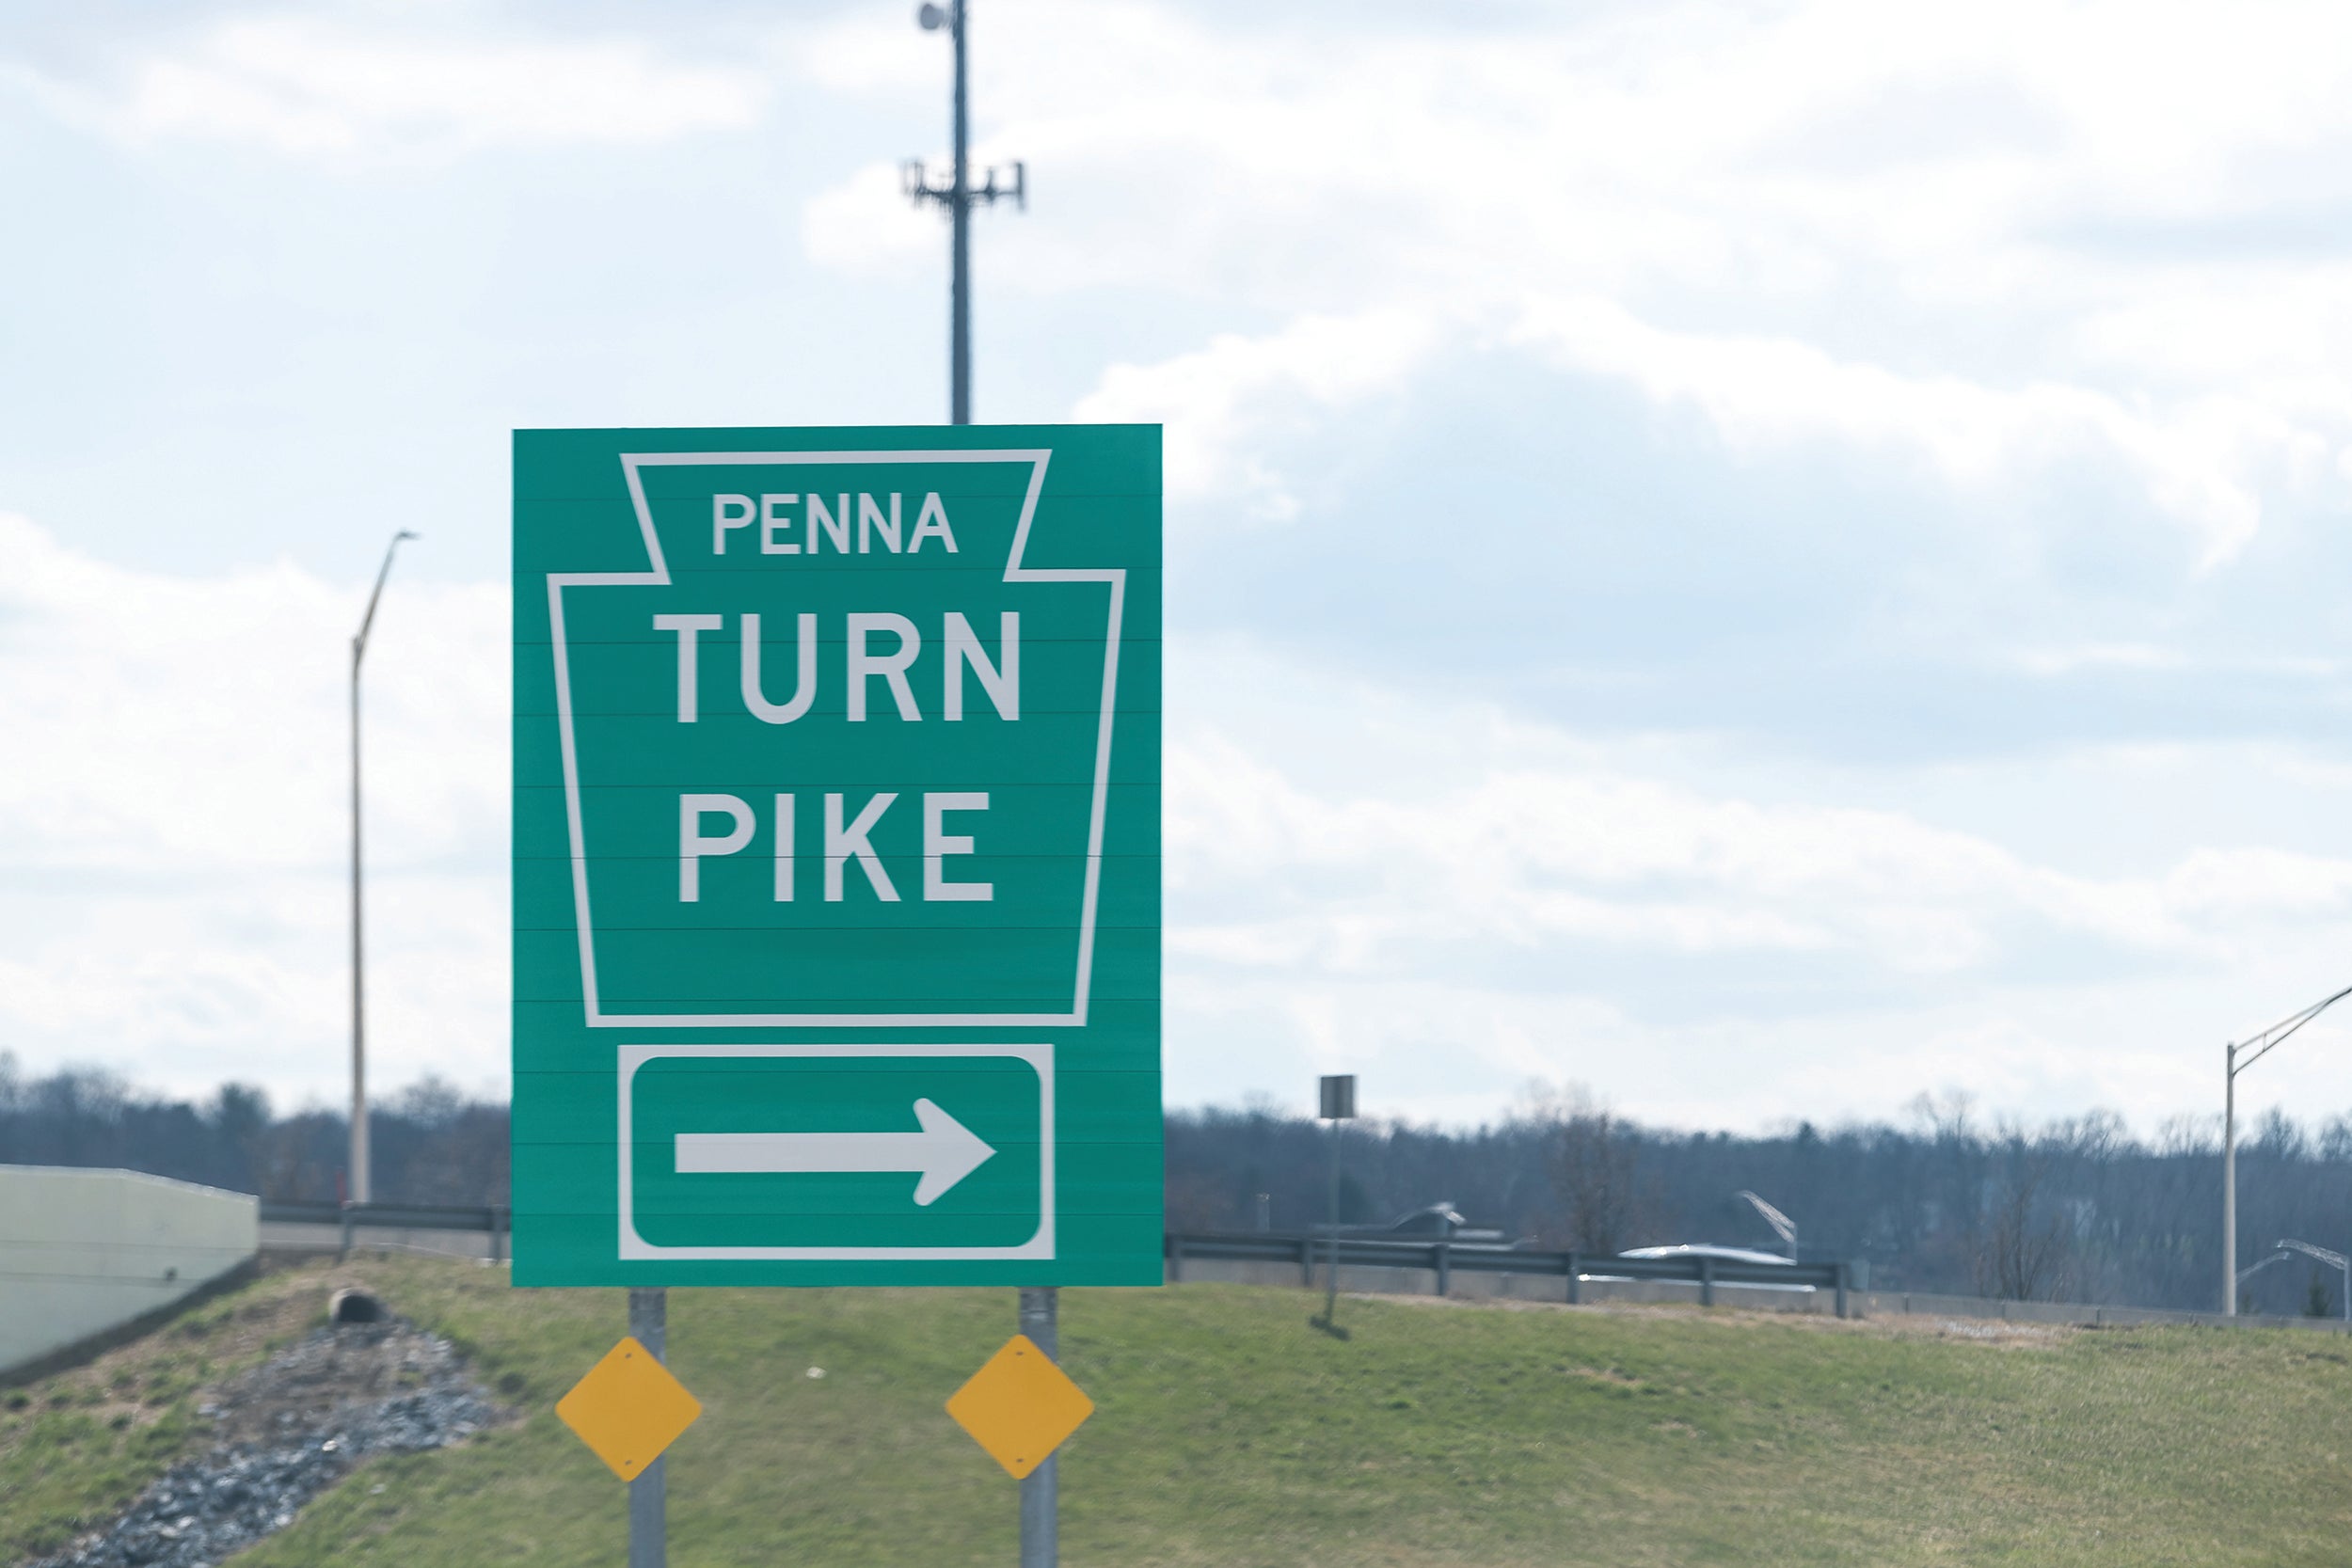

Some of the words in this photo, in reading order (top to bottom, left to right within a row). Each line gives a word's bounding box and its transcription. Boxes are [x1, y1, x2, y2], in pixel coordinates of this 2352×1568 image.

[712, 492, 958, 555] PENNA
[653, 611, 1020, 724] TURN
[678, 792, 993, 903] PIKE
